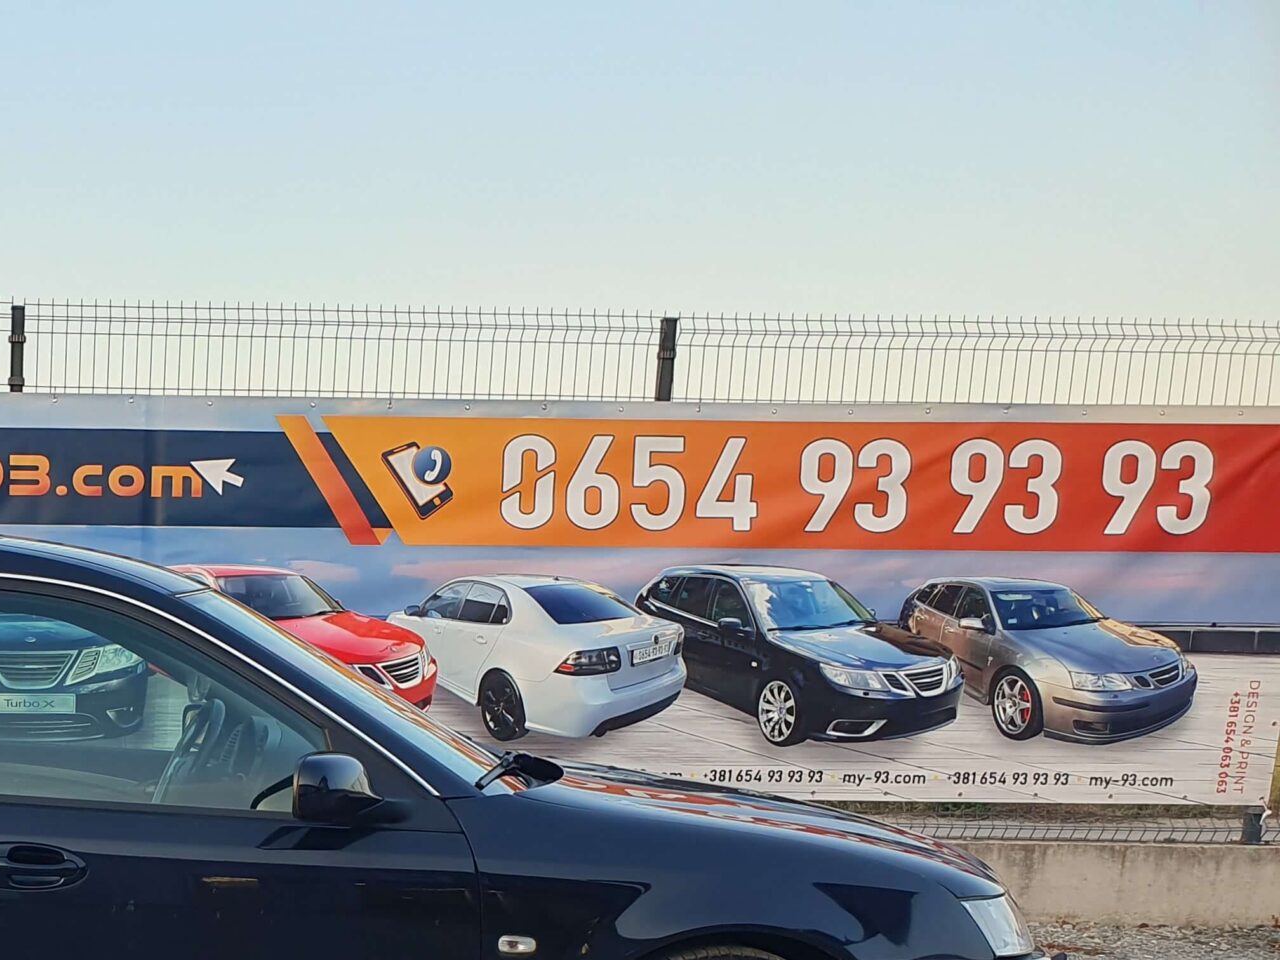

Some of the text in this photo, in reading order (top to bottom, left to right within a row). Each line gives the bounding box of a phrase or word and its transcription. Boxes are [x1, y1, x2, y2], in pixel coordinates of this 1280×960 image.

[500, 433, 1214, 536] 0654 93 93 93
[3, 698, 55, 708] Turbo X
[1224, 721, 1237, 743] 654
[1233, 680, 1261, 794] DESIGN & PRINT
[1220, 747, 1233, 769] 063
[767, 770, 783, 783] 93
[788, 770, 803, 783] 93
[808, 770, 823, 783] 93
[842, 771, 926, 786] my-93.com
[1012, 772, 1027, 785] 93
[1032, 772, 1048, 786] 93
[1053, 773, 1069, 786] 93
[1089, 773, 1174, 789] my-93.com
[1216, 771, 1229, 794] 063
